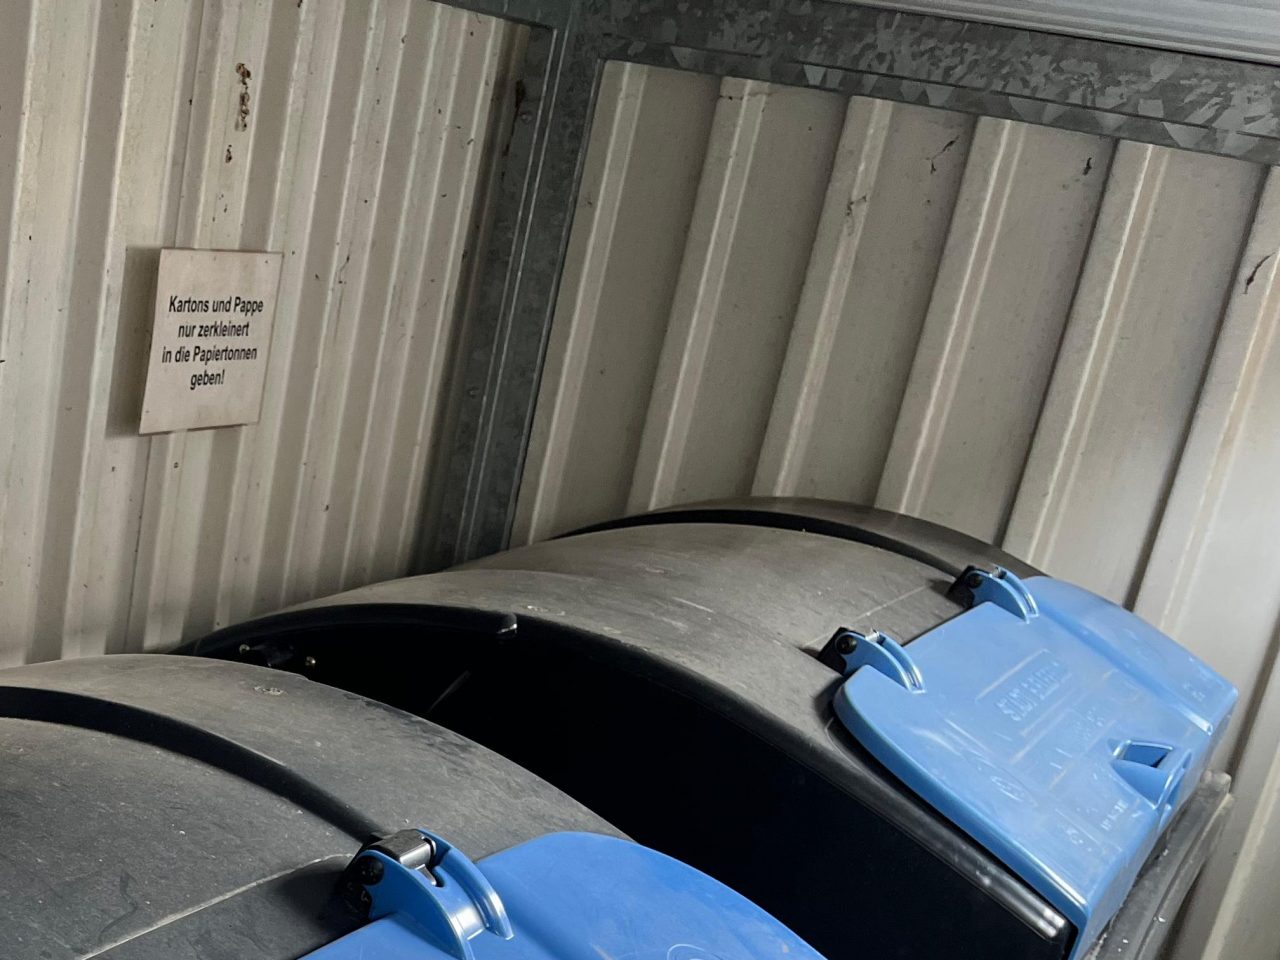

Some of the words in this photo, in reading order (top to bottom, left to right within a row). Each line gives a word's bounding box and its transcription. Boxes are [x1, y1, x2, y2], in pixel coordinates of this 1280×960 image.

[169, 295, 210, 313] Kartons
[212, 296, 232, 313] und
[233, 296, 264, 317] Pappe
[178, 324, 196, 338] nur
[197, 321, 249, 338] zerkleinert
[162, 346, 172, 363] in
[174, 346, 190, 363] die
[192, 346, 257, 366] Papiertonnen
[190, 369, 225, 391] geben!
